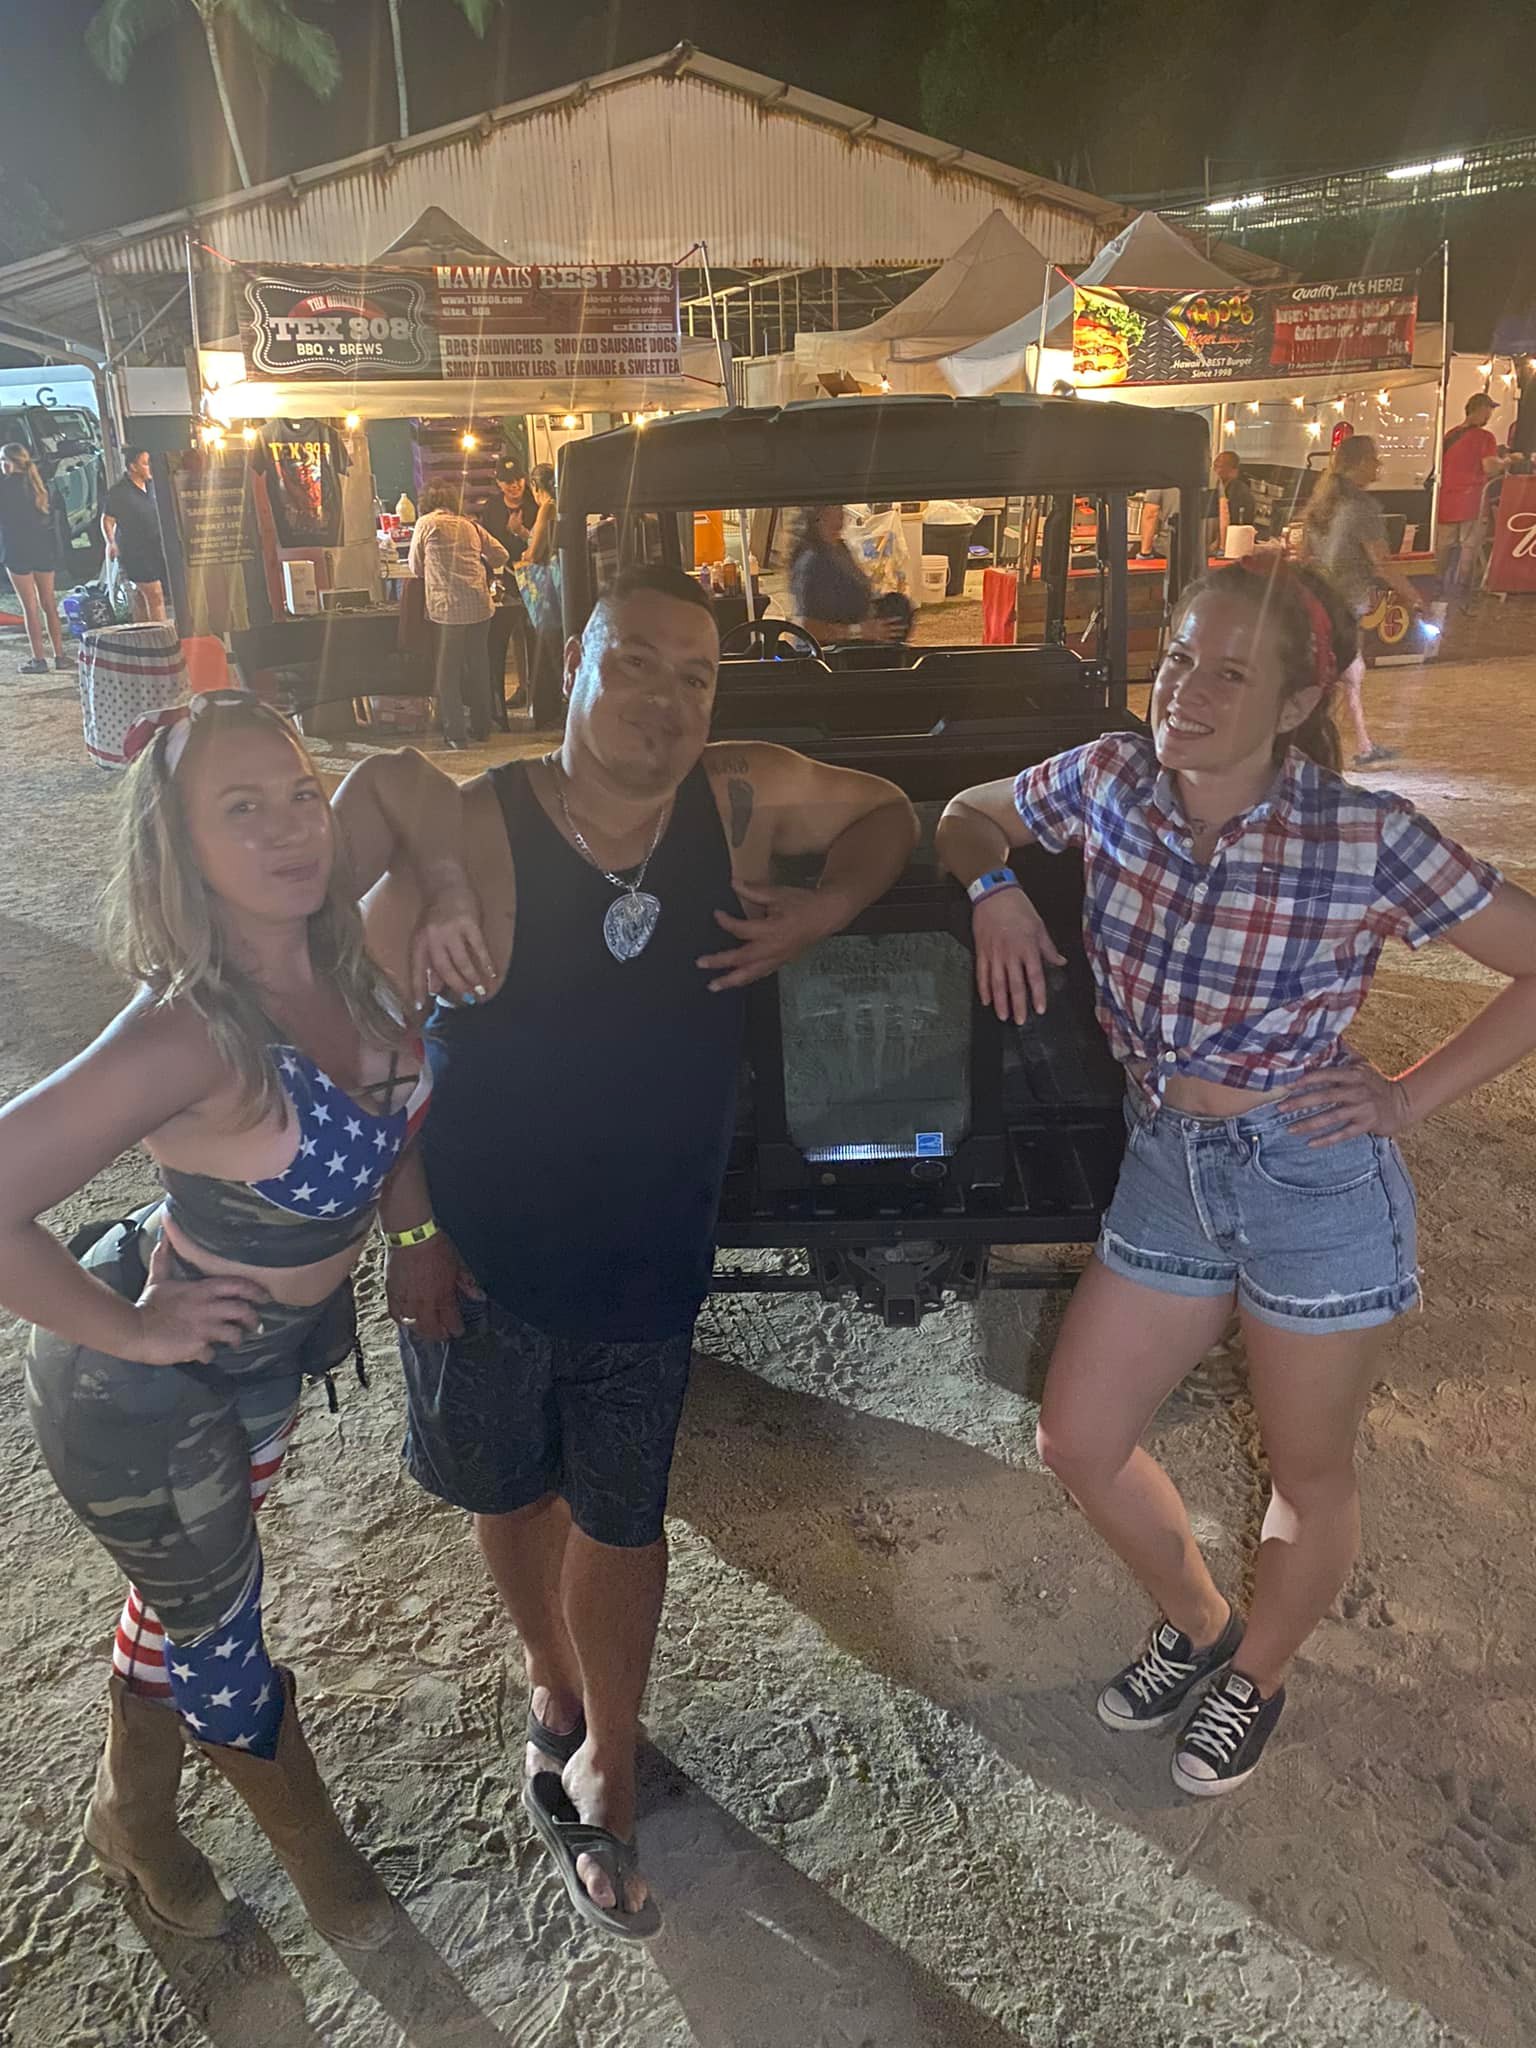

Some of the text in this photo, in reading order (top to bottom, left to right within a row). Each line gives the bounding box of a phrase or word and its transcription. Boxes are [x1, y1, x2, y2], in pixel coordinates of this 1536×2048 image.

[538, 266, 611, 289] BEST
[618, 265, 674, 290] BBQ
[1367, 278, 1405, 295] HERE!
[306, 296, 327, 312] THE
[268, 317, 409, 341] TEX 808
[296, 343, 324, 356] BBQ
[339, 343, 383, 355] BREWS
[446, 338, 543, 357] BBQ SANDWICHES
[554, 336, 678, 354] SMOKED SAUSAGE DOGS
[446, 360, 557, 377] SMOKED TURKEY LEGS
[565, 359, 617, 376] LEMONADE
[628, 358, 661, 375] SWEET
[662, 358, 680, 374] TEA
[1207, 357, 1226, 367] BEST
[1192, 369, 1213, 378] Since
[268, 442, 301, 462] TX
